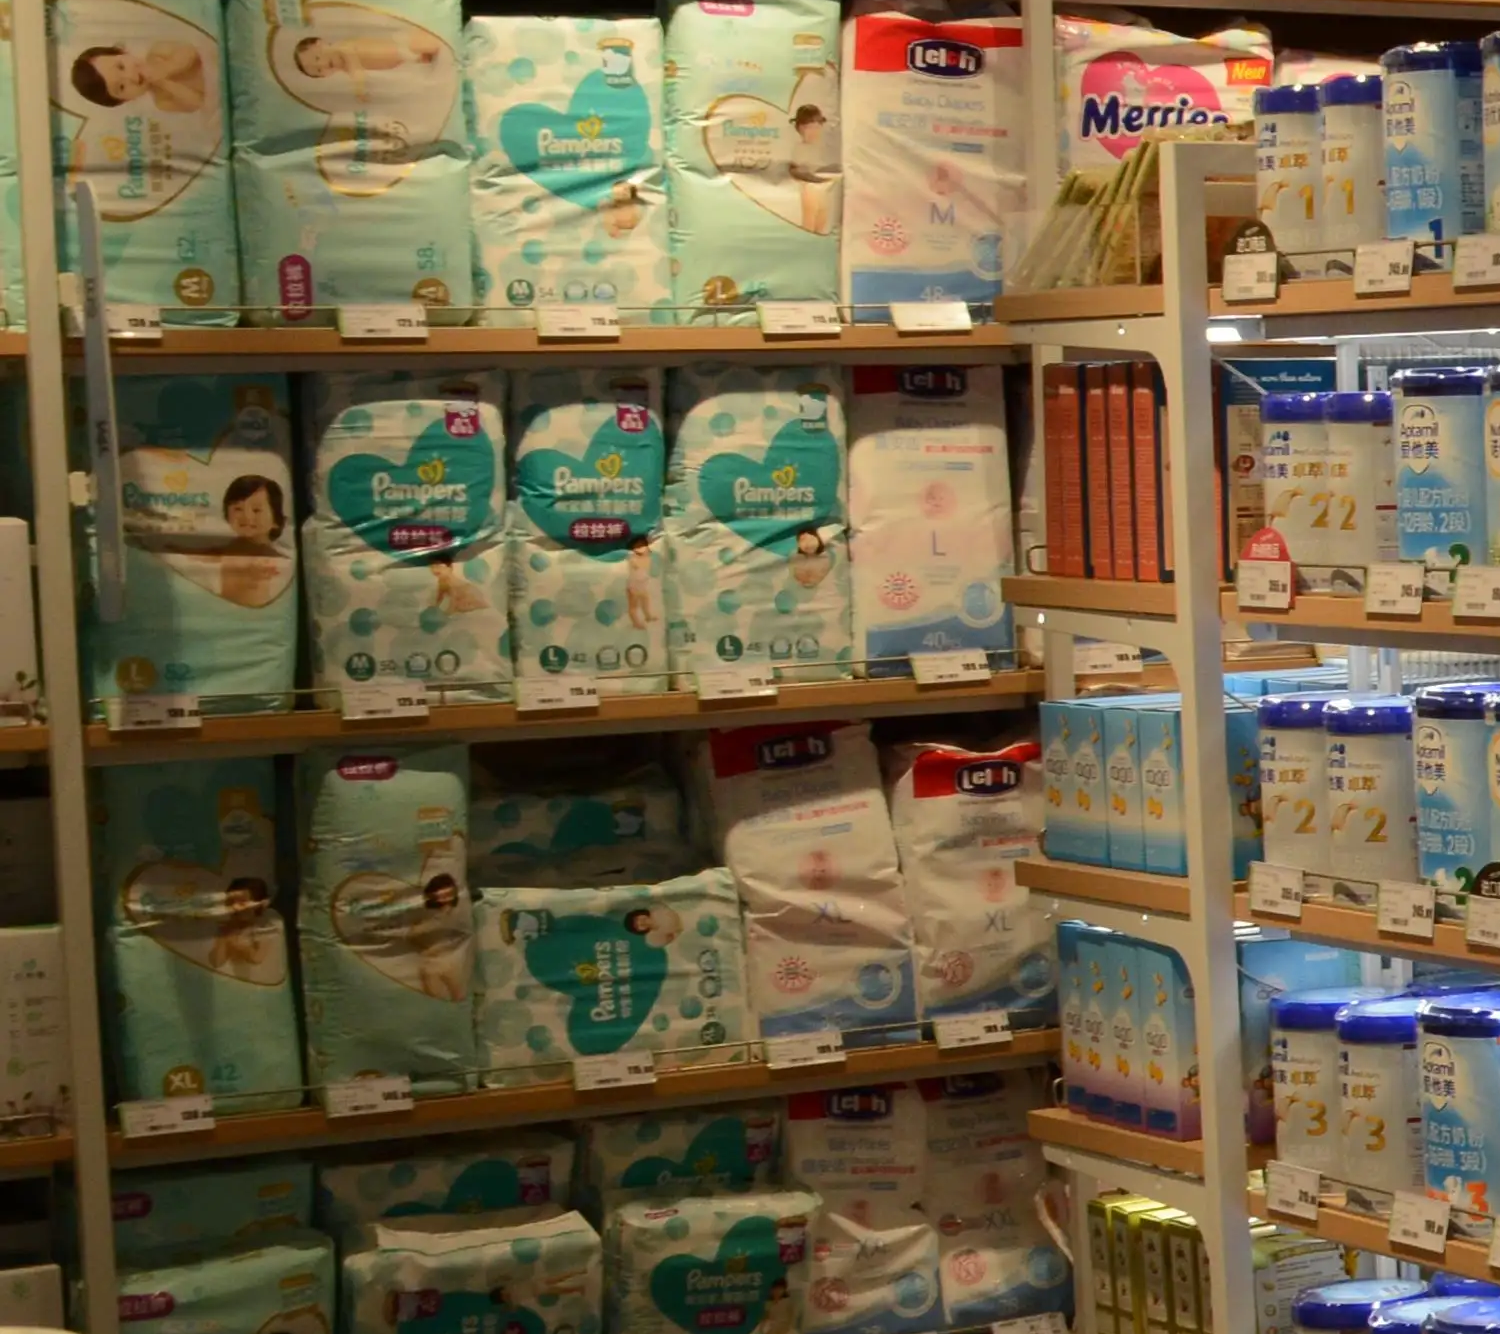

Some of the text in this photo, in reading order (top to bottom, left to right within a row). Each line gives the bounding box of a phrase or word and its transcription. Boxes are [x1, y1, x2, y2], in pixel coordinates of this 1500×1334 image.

[1232, 63, 1265, 81] New
[537, 128, 623, 156] Pampers
[930, 203, 956, 227] M
[371, 472, 467, 507] Pampers
[554, 466, 644, 500] Pampers
[733, 477, 815, 506] Pampers
[931, 531, 946, 557] L
[592, 940, 615, 1023] Pampers
